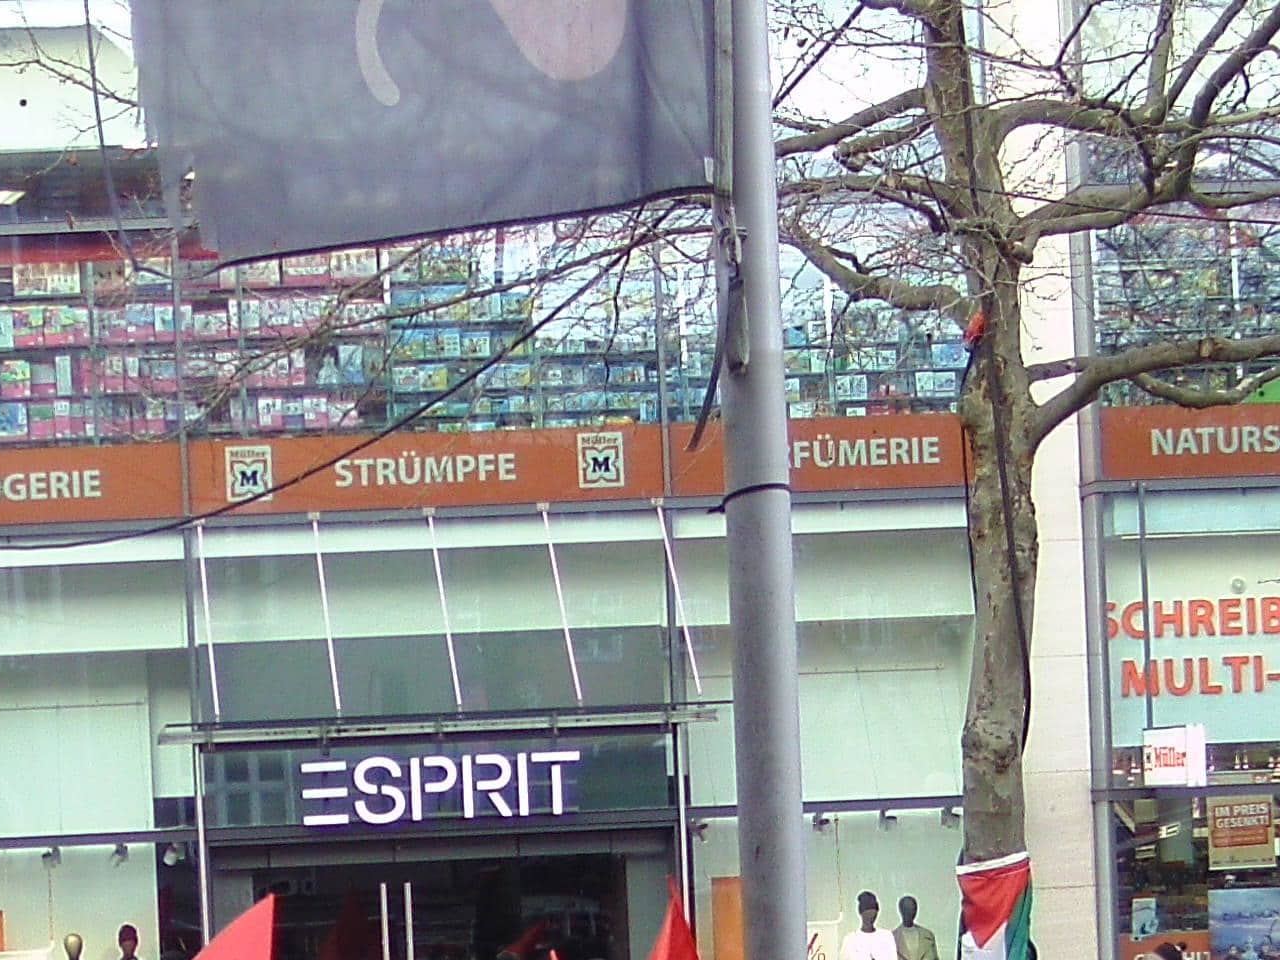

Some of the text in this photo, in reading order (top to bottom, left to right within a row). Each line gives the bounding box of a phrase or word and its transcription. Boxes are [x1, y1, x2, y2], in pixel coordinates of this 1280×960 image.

[591, 456, 610, 473] M
[787, 434, 941, 469] FÜMERIE
[240, 470, 258, 486] M
[334, 452, 517, 488] STRÜMPFE
[300, 751, 581, 825] ESPRIT
